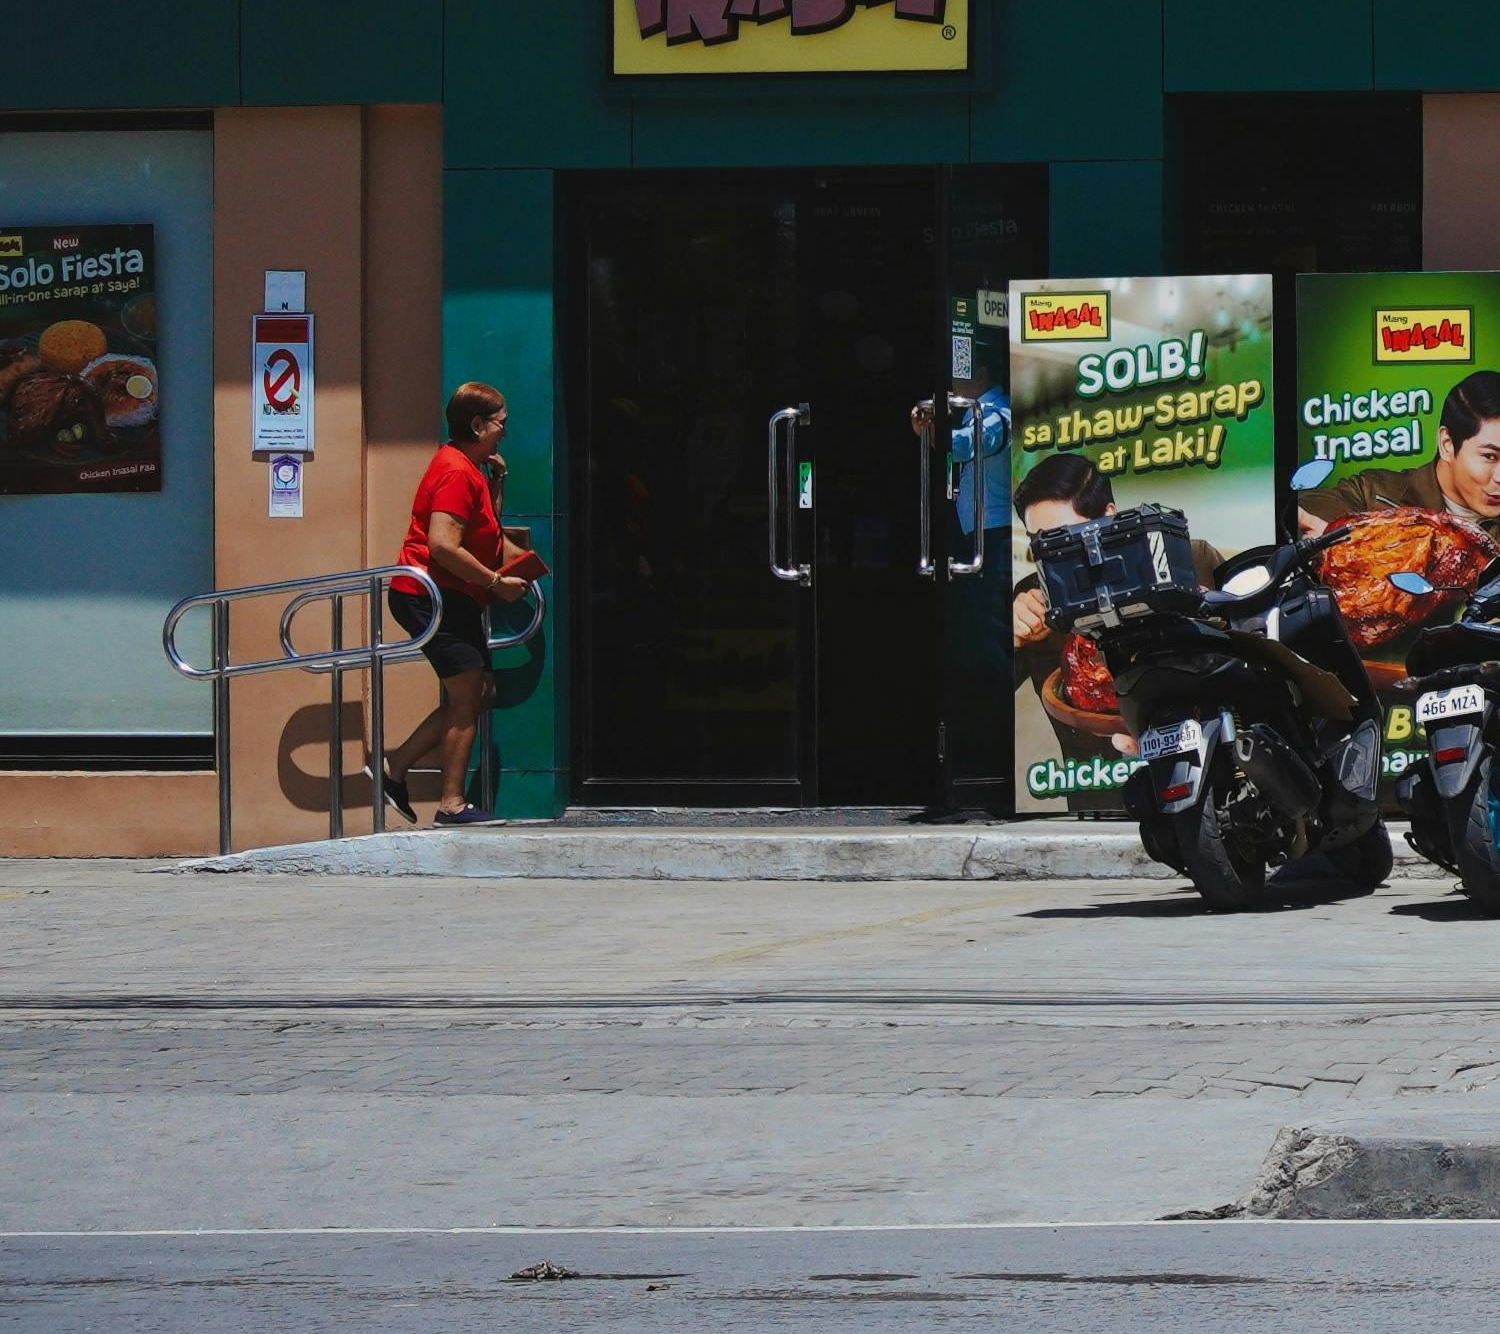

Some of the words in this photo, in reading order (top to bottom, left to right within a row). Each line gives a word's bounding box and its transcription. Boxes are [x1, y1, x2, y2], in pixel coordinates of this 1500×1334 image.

[53, 238, 80, 250] New
[0, 257, 55, 291] Solo
[61, 247, 144, 282] Fiesta
[0, 291, 51, 305] ll-in-One
[54, 285, 89, 299] Sarap
[91, 283, 104, 294] at
[107, 276, 141, 293] Saya!
[1029, 303, 1102, 332] INASAL
[1381, 318, 1465, 352] INASAL
[1382, 314, 1408, 324] Mang
[1078, 331, 1204, 395] SOLB!
[1023, 424, 1051, 446] sa
[1057, 379, 1262, 445] Ihaw-Sarap
[1303, 388, 1431, 426] Chicken
[1098, 445, 1127, 471] at
[1134, 424, 1223, 468] Laki!
[1313, 419, 1421, 460] Inasal
[1422, 699, 1447, 716] 466
[1451, 694, 1478, 711] MZA
